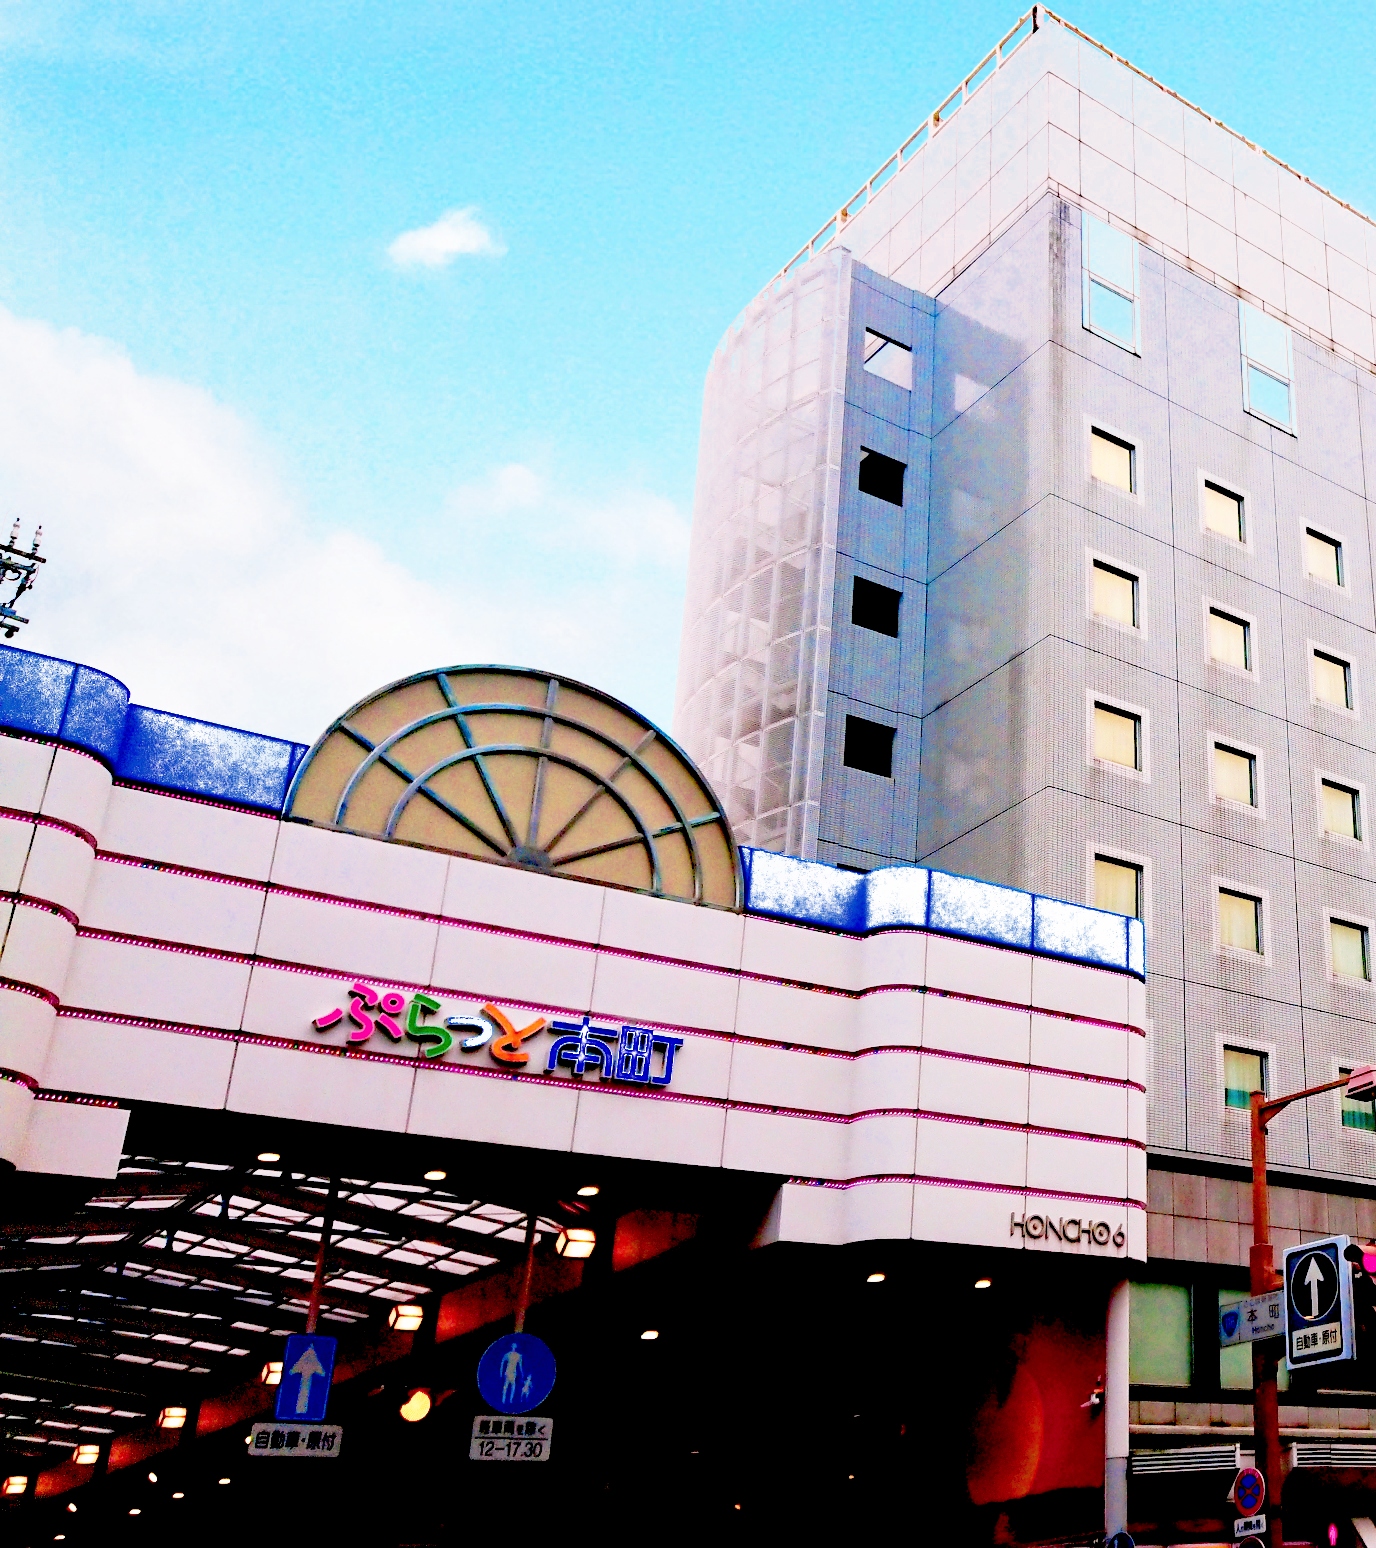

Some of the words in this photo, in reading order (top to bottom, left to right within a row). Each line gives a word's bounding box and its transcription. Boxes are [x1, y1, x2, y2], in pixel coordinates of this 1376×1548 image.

[312, 982, 684, 1087] ぷらっと本町
